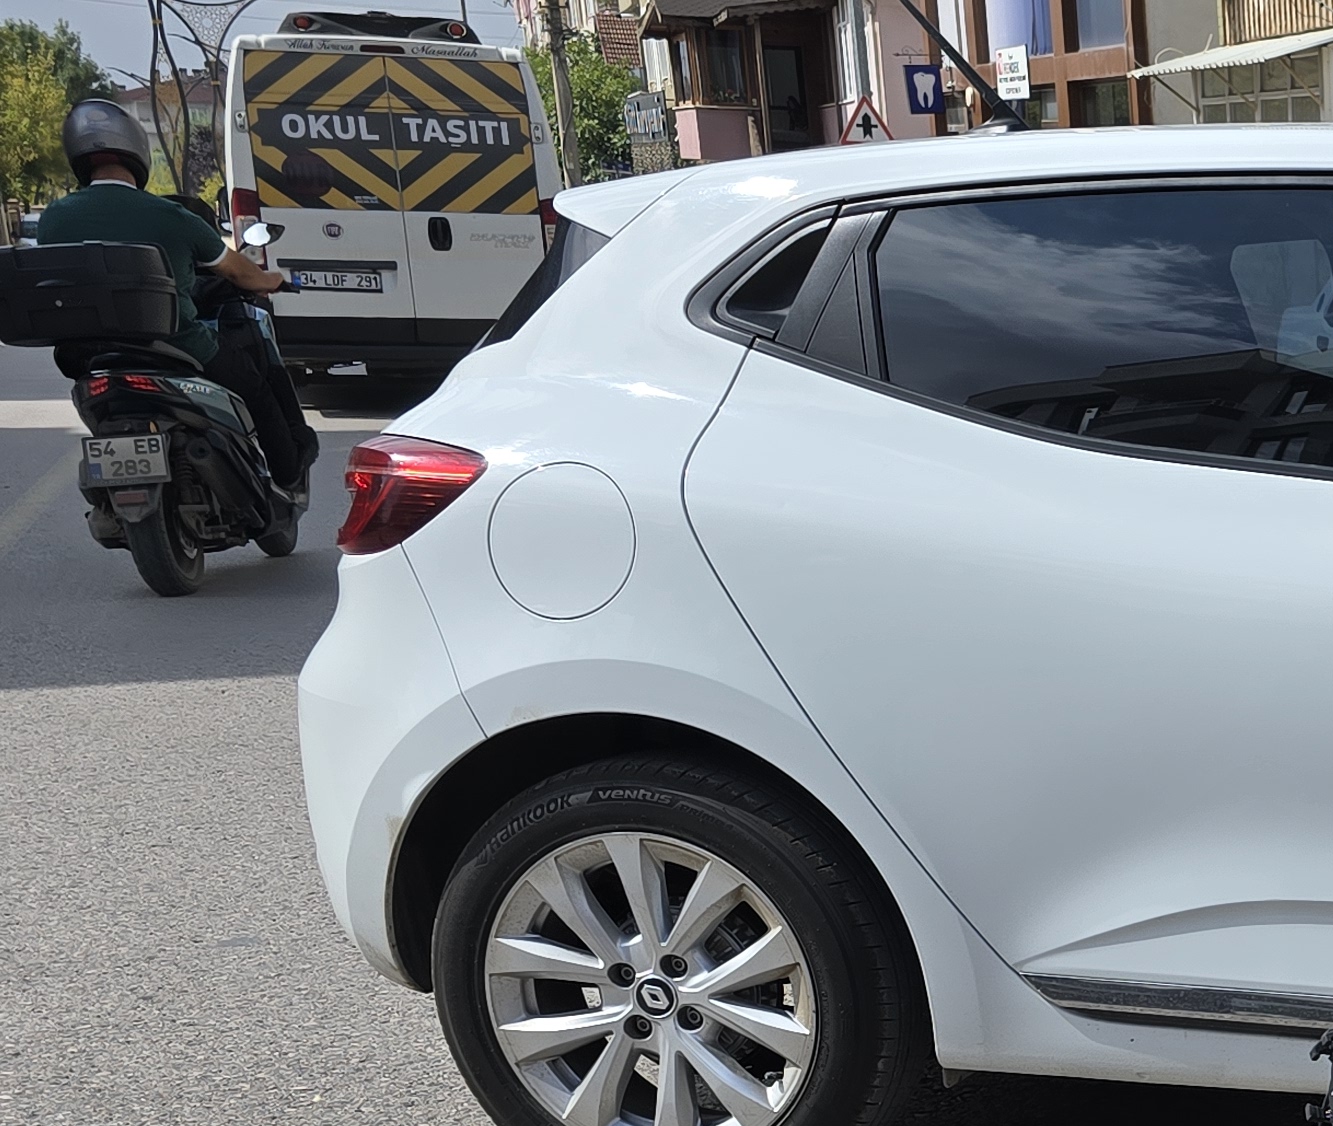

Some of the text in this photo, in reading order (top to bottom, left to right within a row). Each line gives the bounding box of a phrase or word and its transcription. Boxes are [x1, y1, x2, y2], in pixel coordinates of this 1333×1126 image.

[281, 113, 511, 147] OKUL TAŞITI
[300, 272, 379, 289] 34 LDF 291
[88, 437, 161, 458] 54 EB
[110, 458, 151, 478] 283
